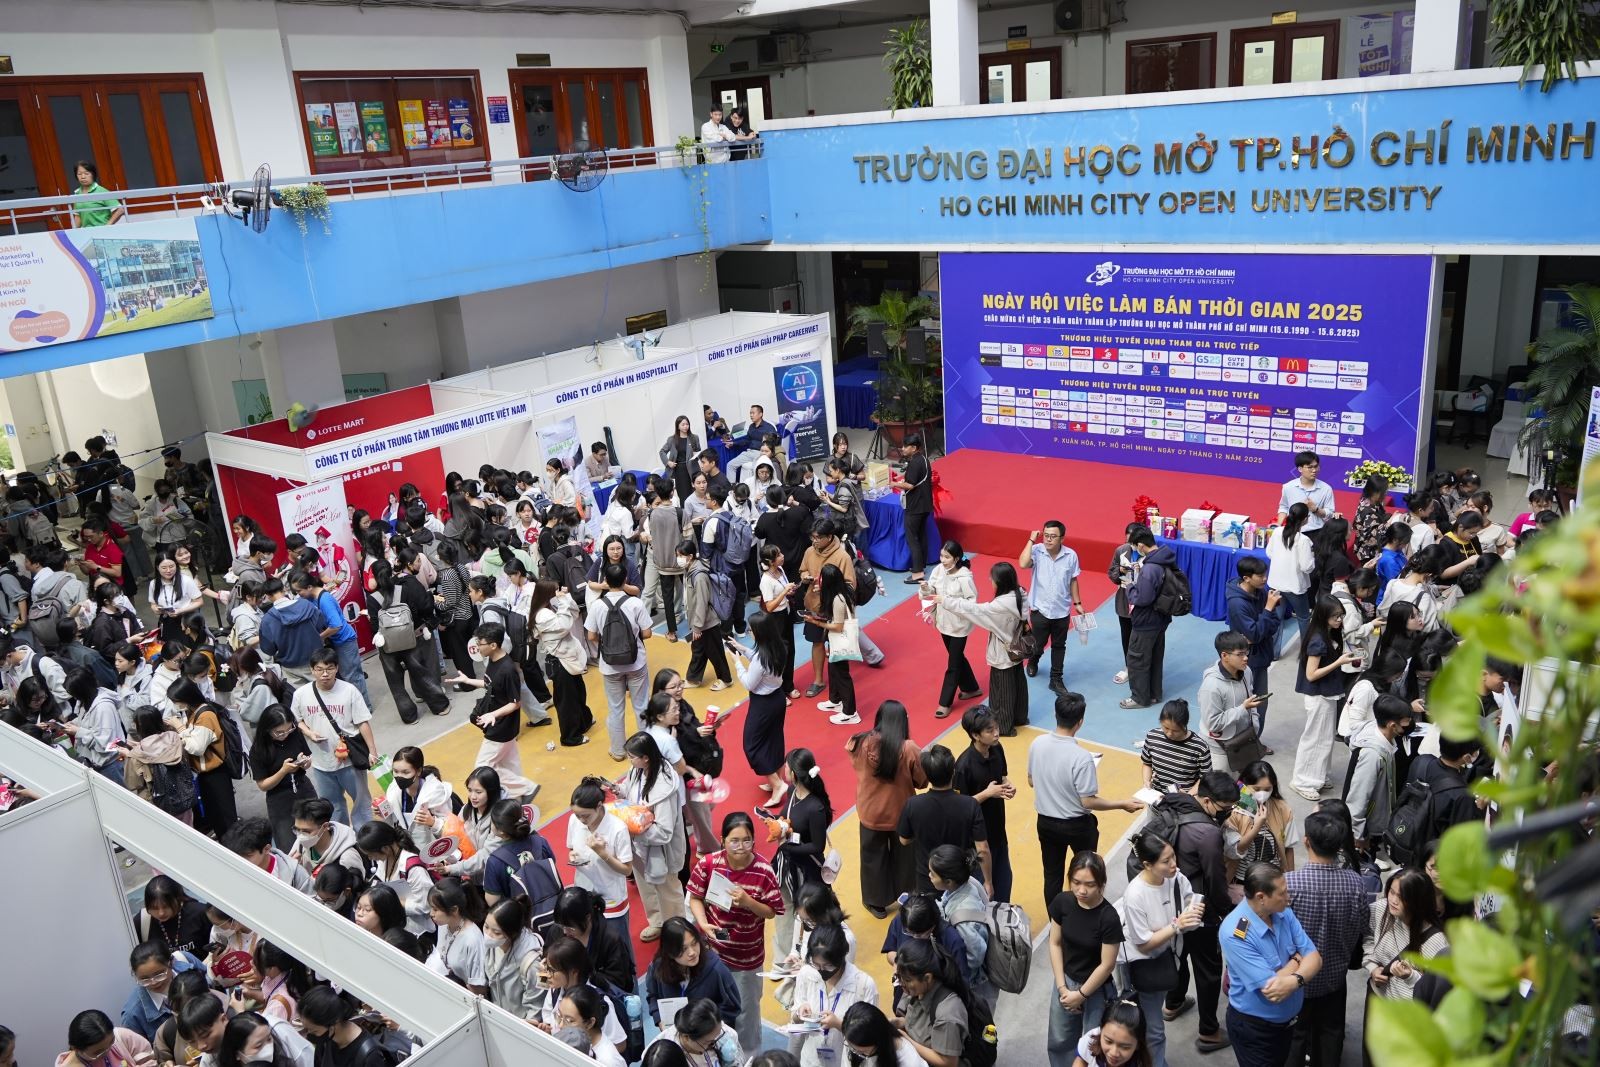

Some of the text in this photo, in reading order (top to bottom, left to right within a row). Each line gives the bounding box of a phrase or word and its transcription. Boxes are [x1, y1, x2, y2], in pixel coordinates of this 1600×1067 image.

[853, 146, 988, 183] TRƯỜNG
[996, 148, 1052, 184] ĐẠI
[1063, 144, 1142, 184] HỌC
[1154, 132, 1219, 175] MỞ
[1370, 119, 1453, 167] CHÍ
[1466, 121, 1597, 163] MINH
[940, 185, 1443, 217] HO CHI MINH CITY OPEN UNIVERSITY
[1123, 267, 1148, 275] TRƯỜNG
[1149, 268, 1160, 276] ĐẠI
[1160, 268, 1173, 276] HỌC
[983, 291, 1363, 321] NGÀY HỘI VIỆC LÀM BÁN THỜI GIAN 2025
[1249, 325, 1268, 333] MINH
[1270, 325, 1309, 335] (15.6.1990
[1318, 328, 1360, 337] 15.6.2025)
[708, 349, 725, 362] CÔNG
[725, 348, 734, 357] TY
[743, 340, 760, 354] PHẦN
[772, 331, 788, 346] PHÁP
[788, 324, 819, 340] CAREERVIET
[1060, 334, 1091, 342] THƯƠNG
[1094, 335, 1112, 344] HIỆU
[1144, 338, 1166, 346] DỤNG
[1214, 342, 1237, 350] TRỰC
[1240, 342, 1260, 350] TIẾP
[556, 362, 678, 404] CÔNG TY CỔ PHẦN IN HOSPITALITY
[793, 375, 805, 386] AI
[1060, 378, 1089, 387] THƯƠNG
[1092, 381, 1110, 389] HIỆU
[1164, 386, 1186, 394] THAM
[318, 417, 365, 436] LOTTE MART
[315, 403, 527, 469] CÔNG TY CỔ PHẦN TRUNG TÂM THƯƠNG MẠI LOTTE VIỆT NAM
[363, 465, 382, 478] LÀM
[224, 956, 237, 965] JOIN
[227, 960, 240, 969] OUR
[228, 962, 246, 973] TEAM!
